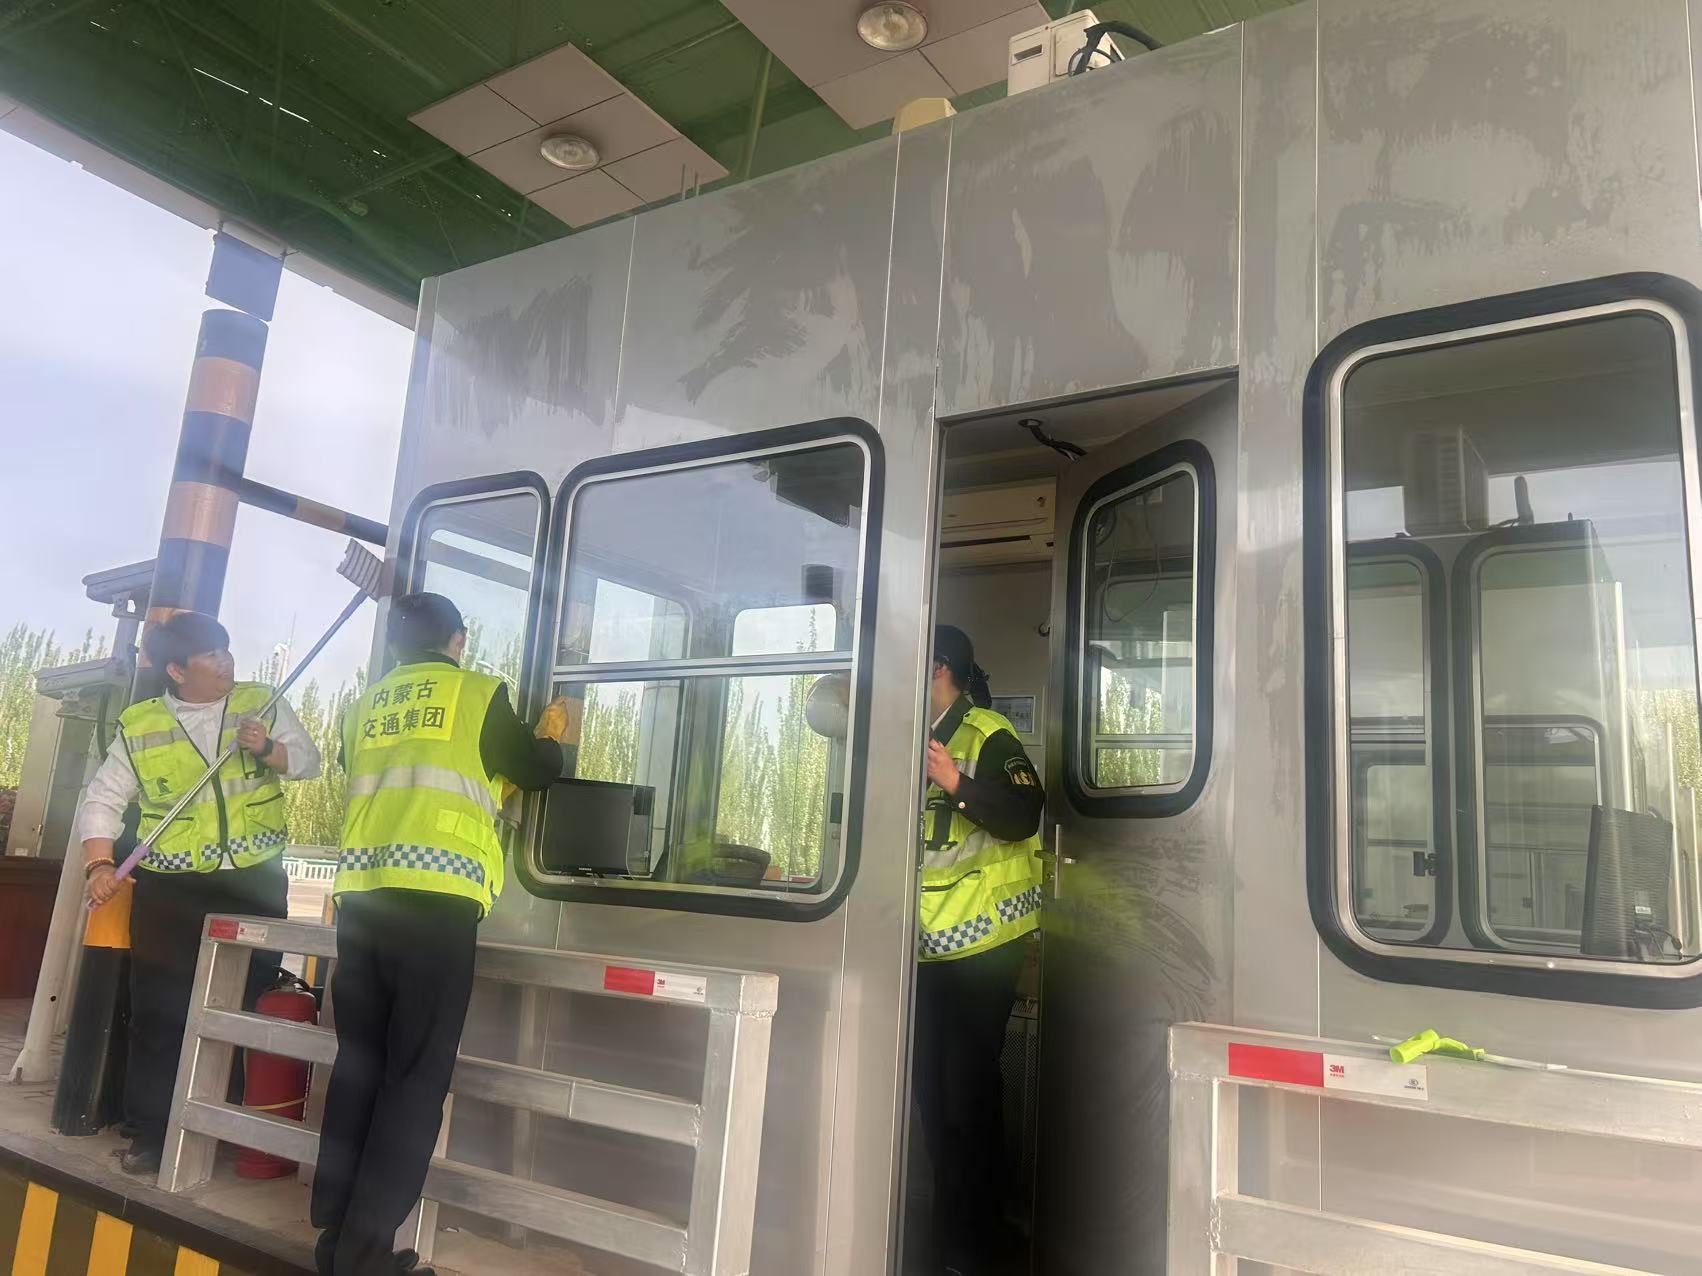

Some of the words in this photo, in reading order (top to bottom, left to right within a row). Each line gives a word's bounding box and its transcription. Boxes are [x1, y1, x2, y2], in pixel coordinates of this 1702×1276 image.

[372, 679, 437, 709] 内蒙古
[362, 707, 445, 740] 交通集团
[1329, 1064, 1344, 1073] 3M
